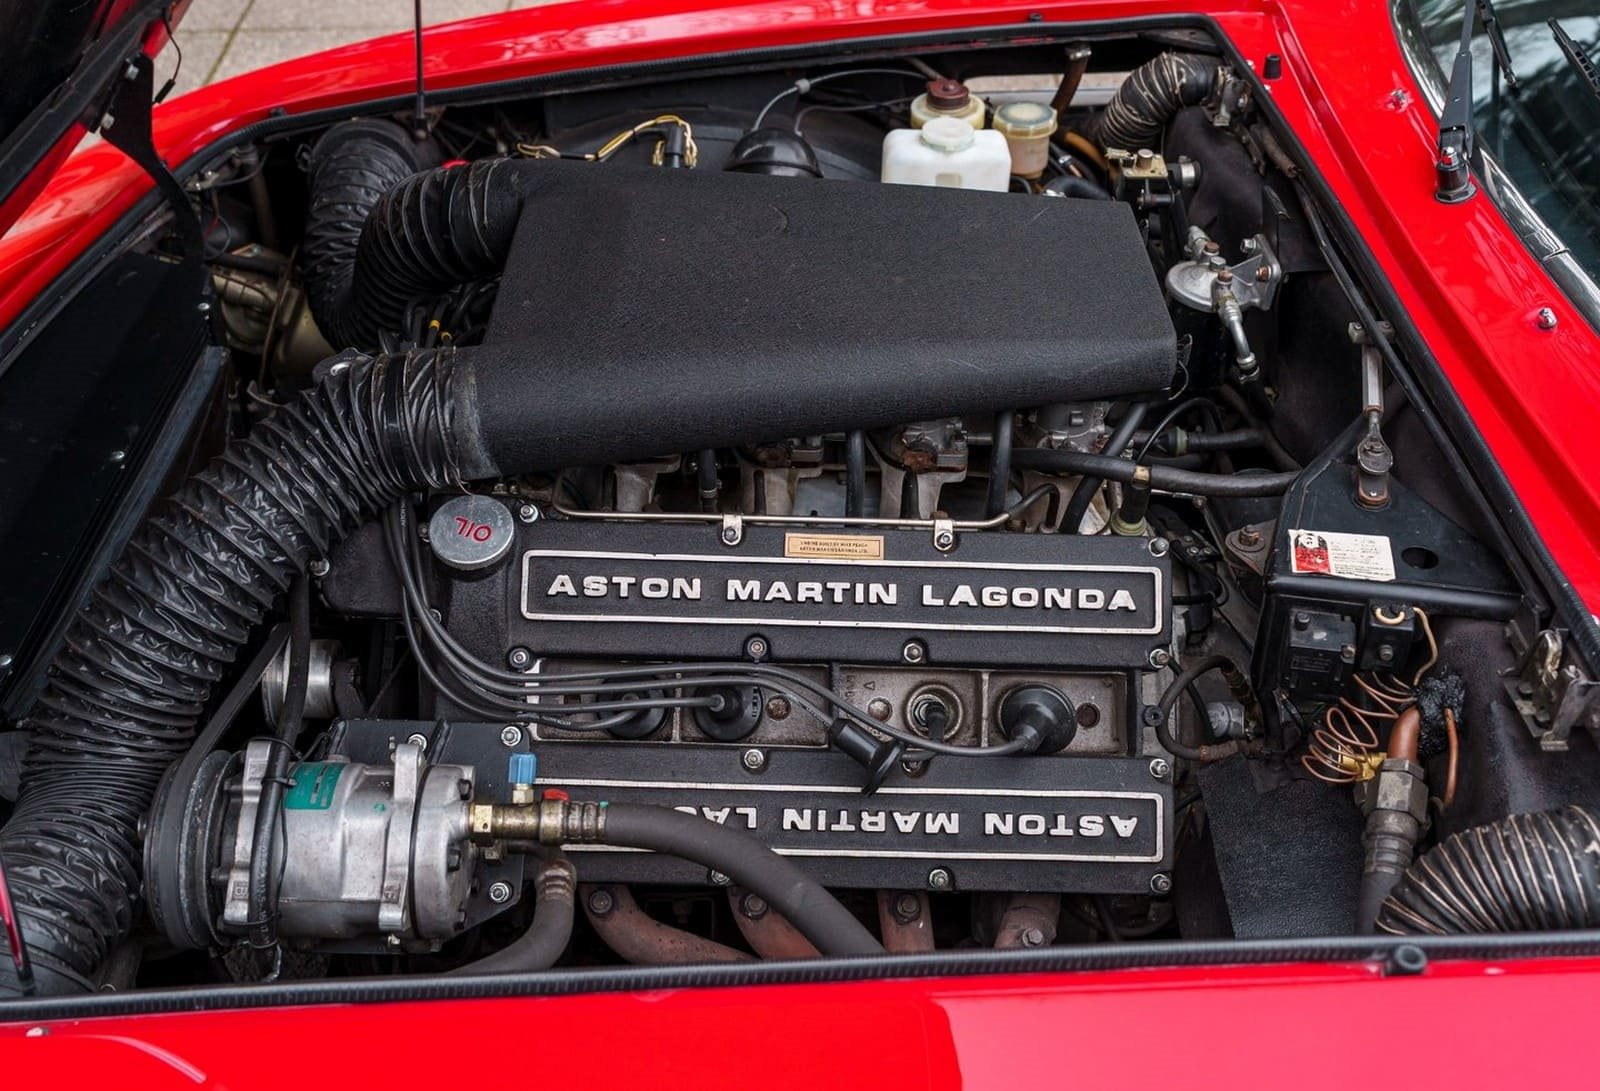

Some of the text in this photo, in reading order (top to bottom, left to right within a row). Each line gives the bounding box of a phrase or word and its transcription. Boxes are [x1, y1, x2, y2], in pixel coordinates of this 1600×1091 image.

[455, 516, 493, 543] OIL
[547, 574, 1137, 611] ASTON MARTIN LAGONDA
[782, 808, 960, 834] MARTIN
[984, 812, 1138, 838] ASTON
